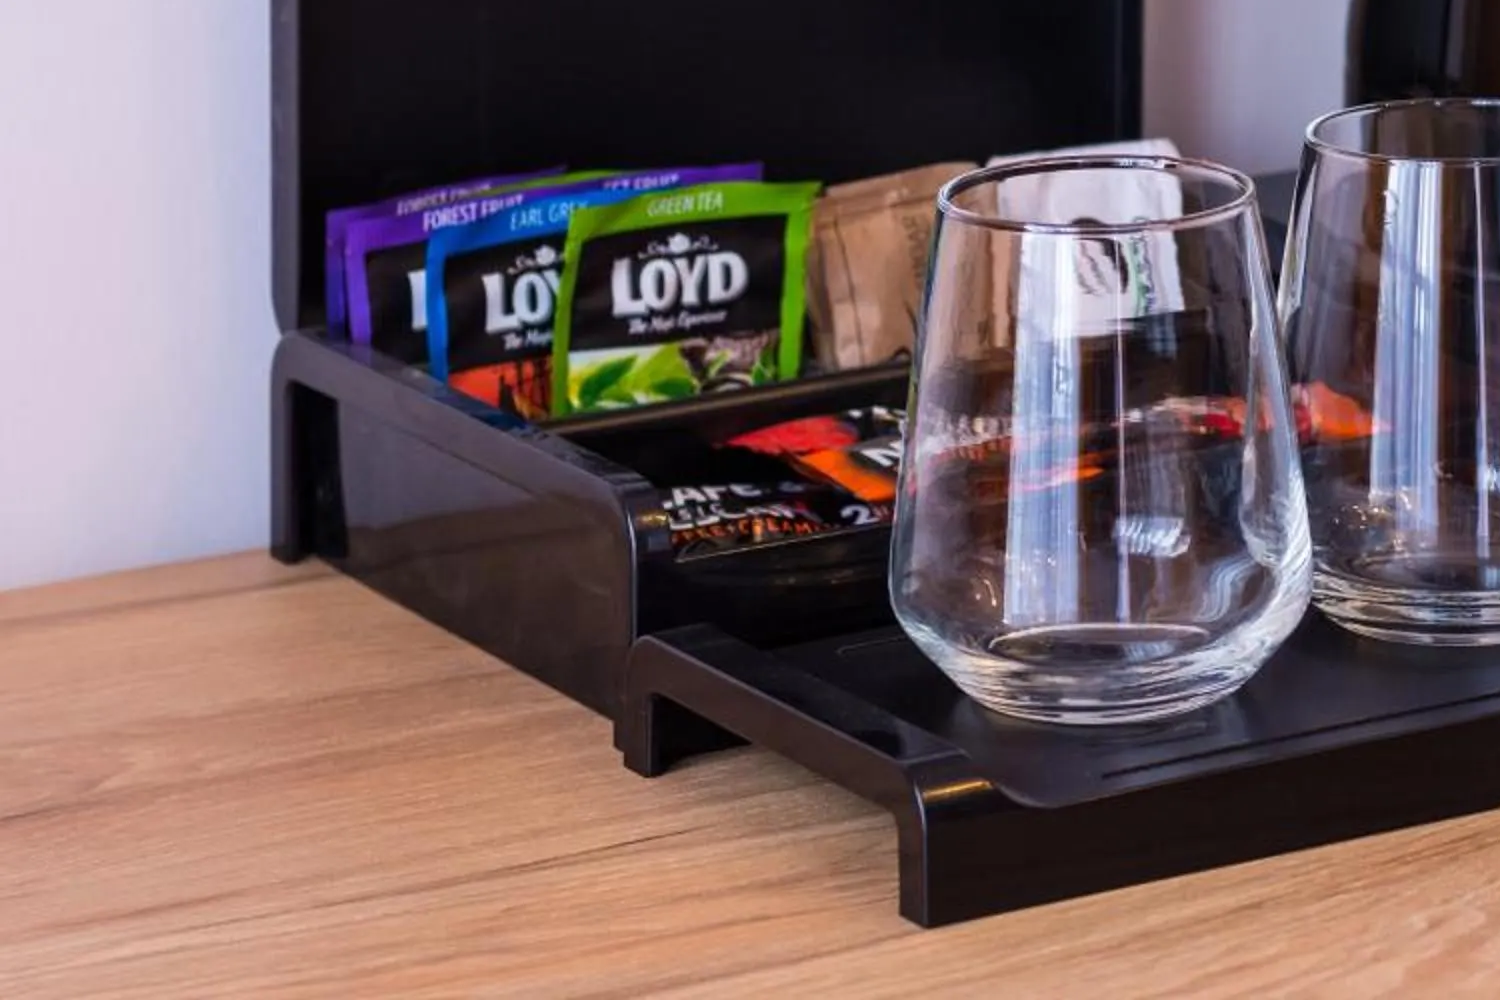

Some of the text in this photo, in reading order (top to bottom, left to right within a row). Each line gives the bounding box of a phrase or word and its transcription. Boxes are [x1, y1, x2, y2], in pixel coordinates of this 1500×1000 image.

[422, 201, 478, 232] FOREST
[646, 189, 723, 217] GREEN TEA
[510, 206, 544, 231] EARL
[611, 250, 749, 319] LOYD
